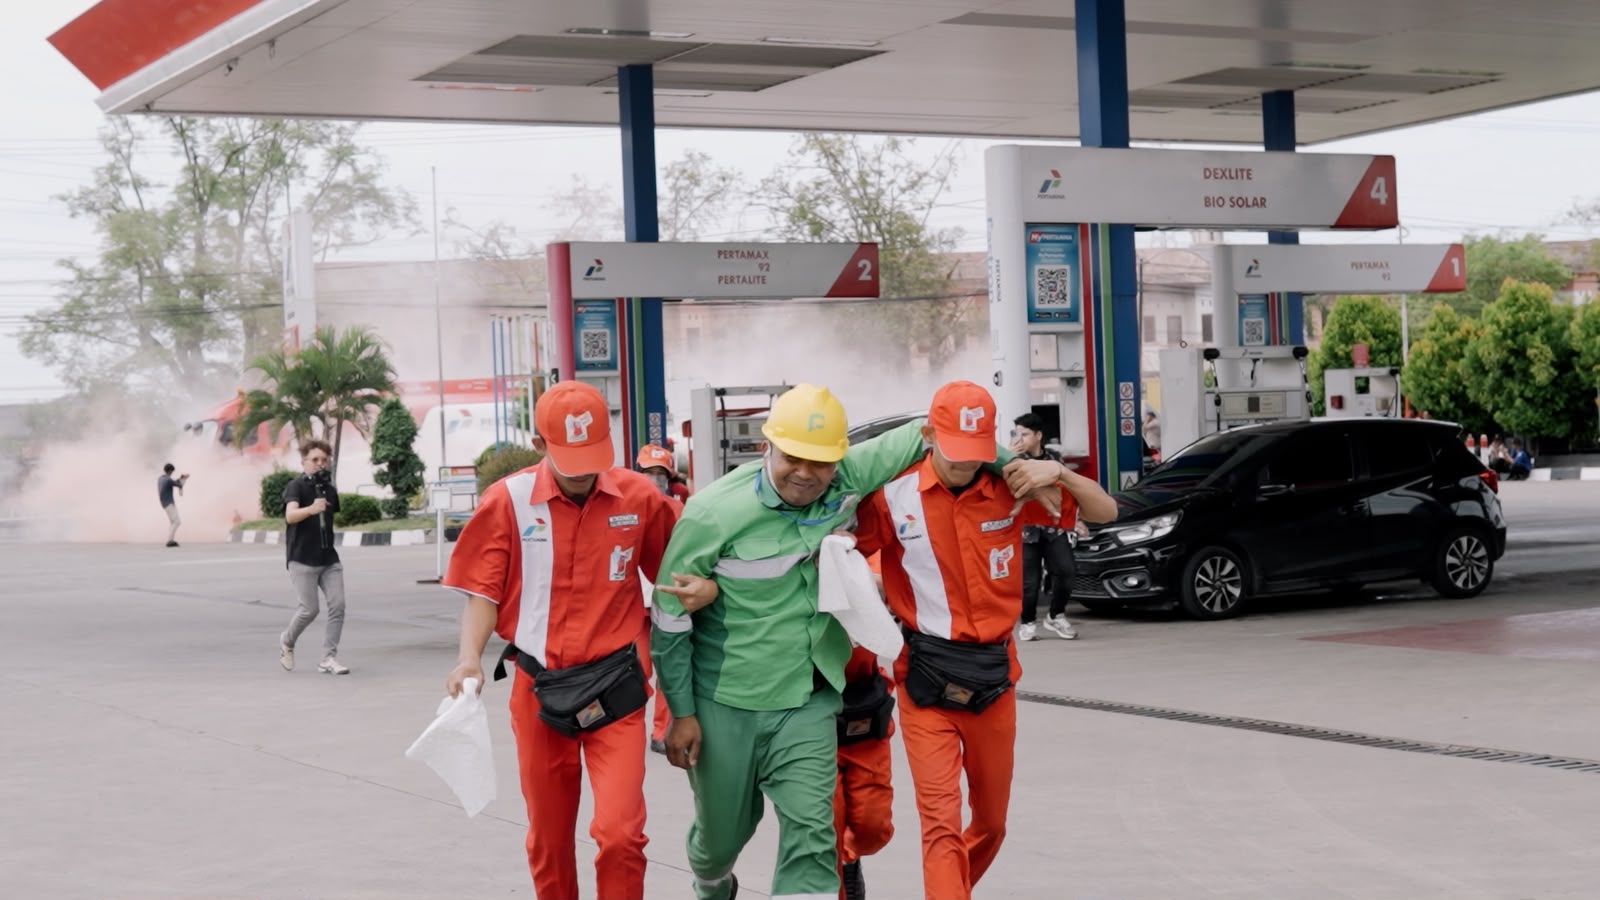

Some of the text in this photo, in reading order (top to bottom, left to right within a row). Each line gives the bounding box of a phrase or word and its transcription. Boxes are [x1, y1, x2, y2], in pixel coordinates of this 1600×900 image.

[1203, 167, 1253, 180] DEXLITE
[1370, 176, 1389, 206] 4
[1203, 196, 1267, 209] BIO SOLAR
[717, 249, 769, 260] PERTAMAX
[758, 262, 770, 272] 92
[857, 258, 873, 281] 2
[1450, 257, 1460, 277] 1
[717, 275, 768, 285] PERTALITE
